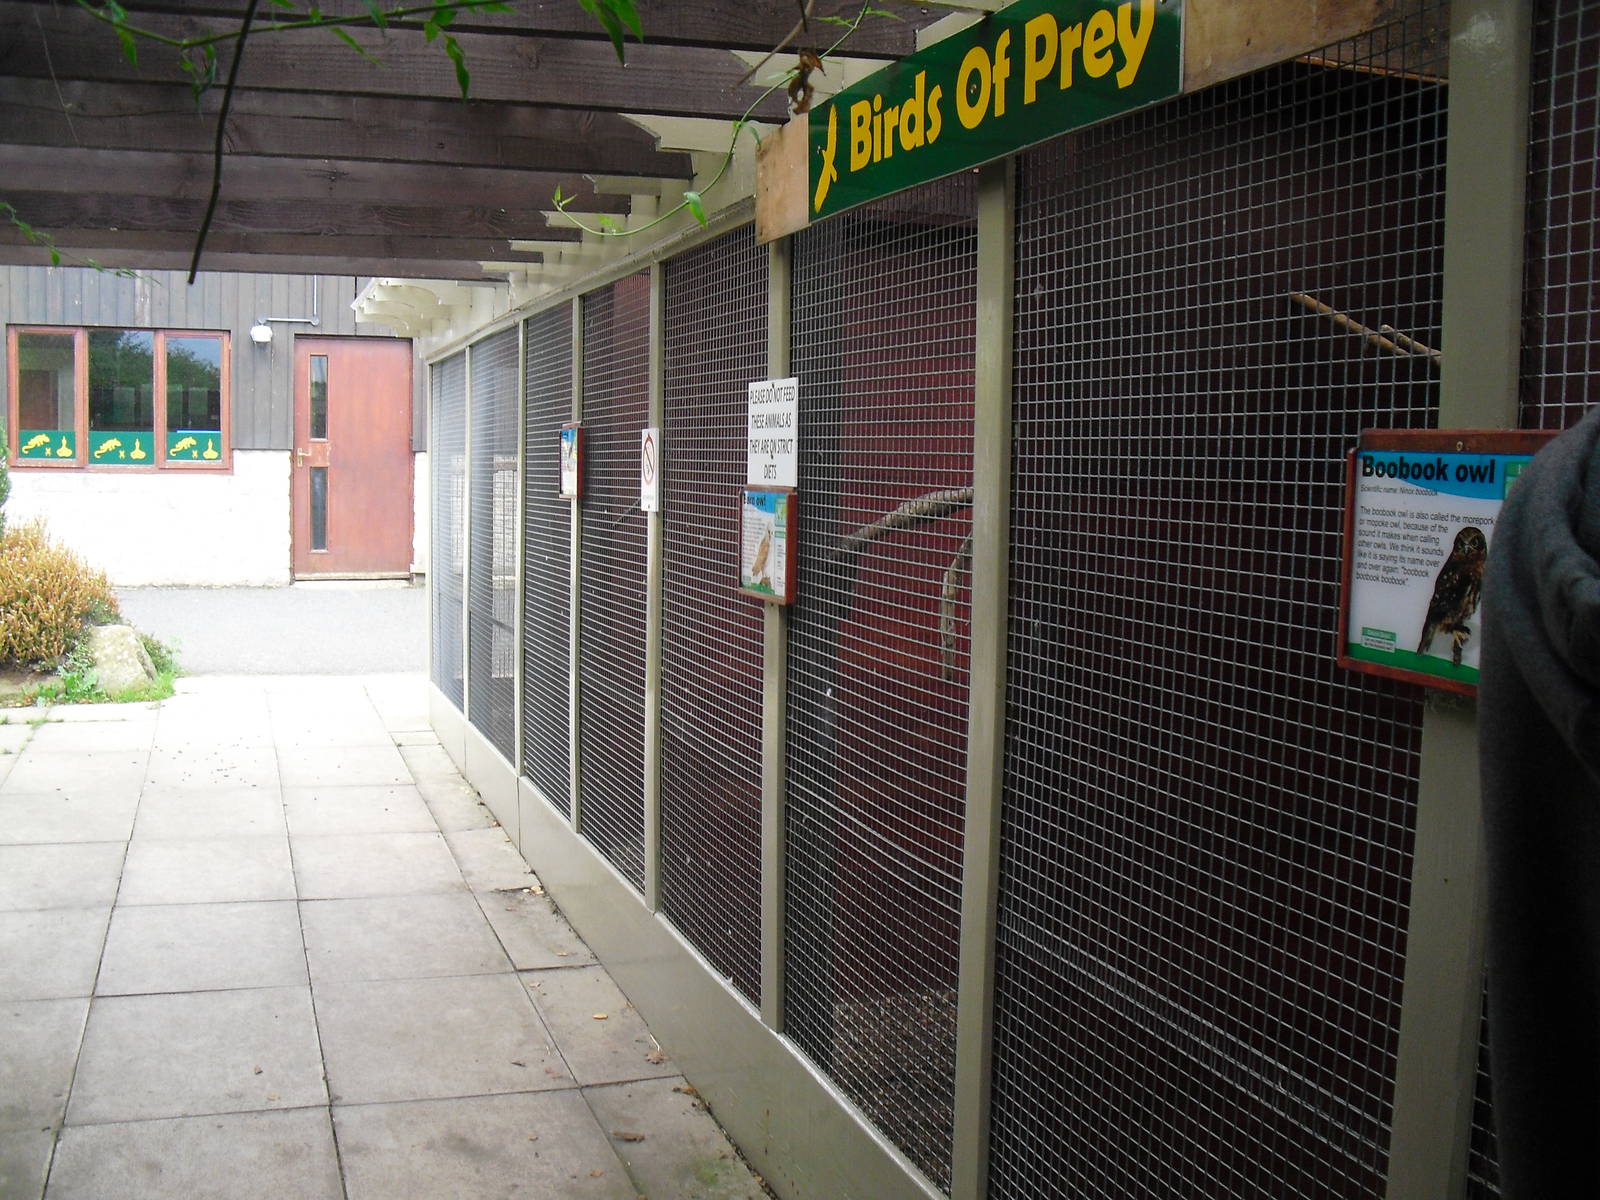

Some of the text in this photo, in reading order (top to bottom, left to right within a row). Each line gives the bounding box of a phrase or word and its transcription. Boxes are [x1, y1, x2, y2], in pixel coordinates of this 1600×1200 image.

[850, 0, 1155, 173] Birds Of Prey
[750, 386, 795, 404] PLEASE DO NOT FEED
[752, 412, 792, 429] THESE ANIMALS AS
[750, 439, 793, 454] THEY ARE ON STRICT
[764, 464, 776, 479] DIETS
[1362, 455, 1448, 481] Boobook
[1455, 459, 1496, 484] owl
[1361, 506, 1370, 515] The
[1372, 508, 1396, 517] boobook
[1416, 512, 1429, 520] also
[1430, 512, 1449, 521] called
[1450, 513, 1461, 523] the
[1403, 522, 1428, 531] because
[1430, 524, 1437, 532] of
[1438, 524, 1448, 533] the
[1382, 531, 1400, 540] makes
[1420, 534, 1439, 546] calling
[1389, 542, 1399, 551] We
[1400, 543, 1414, 552] think
[1421, 547, 1444, 556] sounds
[1357, 561, 1367, 569] and
[1368, 563, 1381, 571] over
[1379, 554, 1398, 563] saying
[1407, 557, 1424, 565] name
[1356, 572, 1379, 582] boobook
